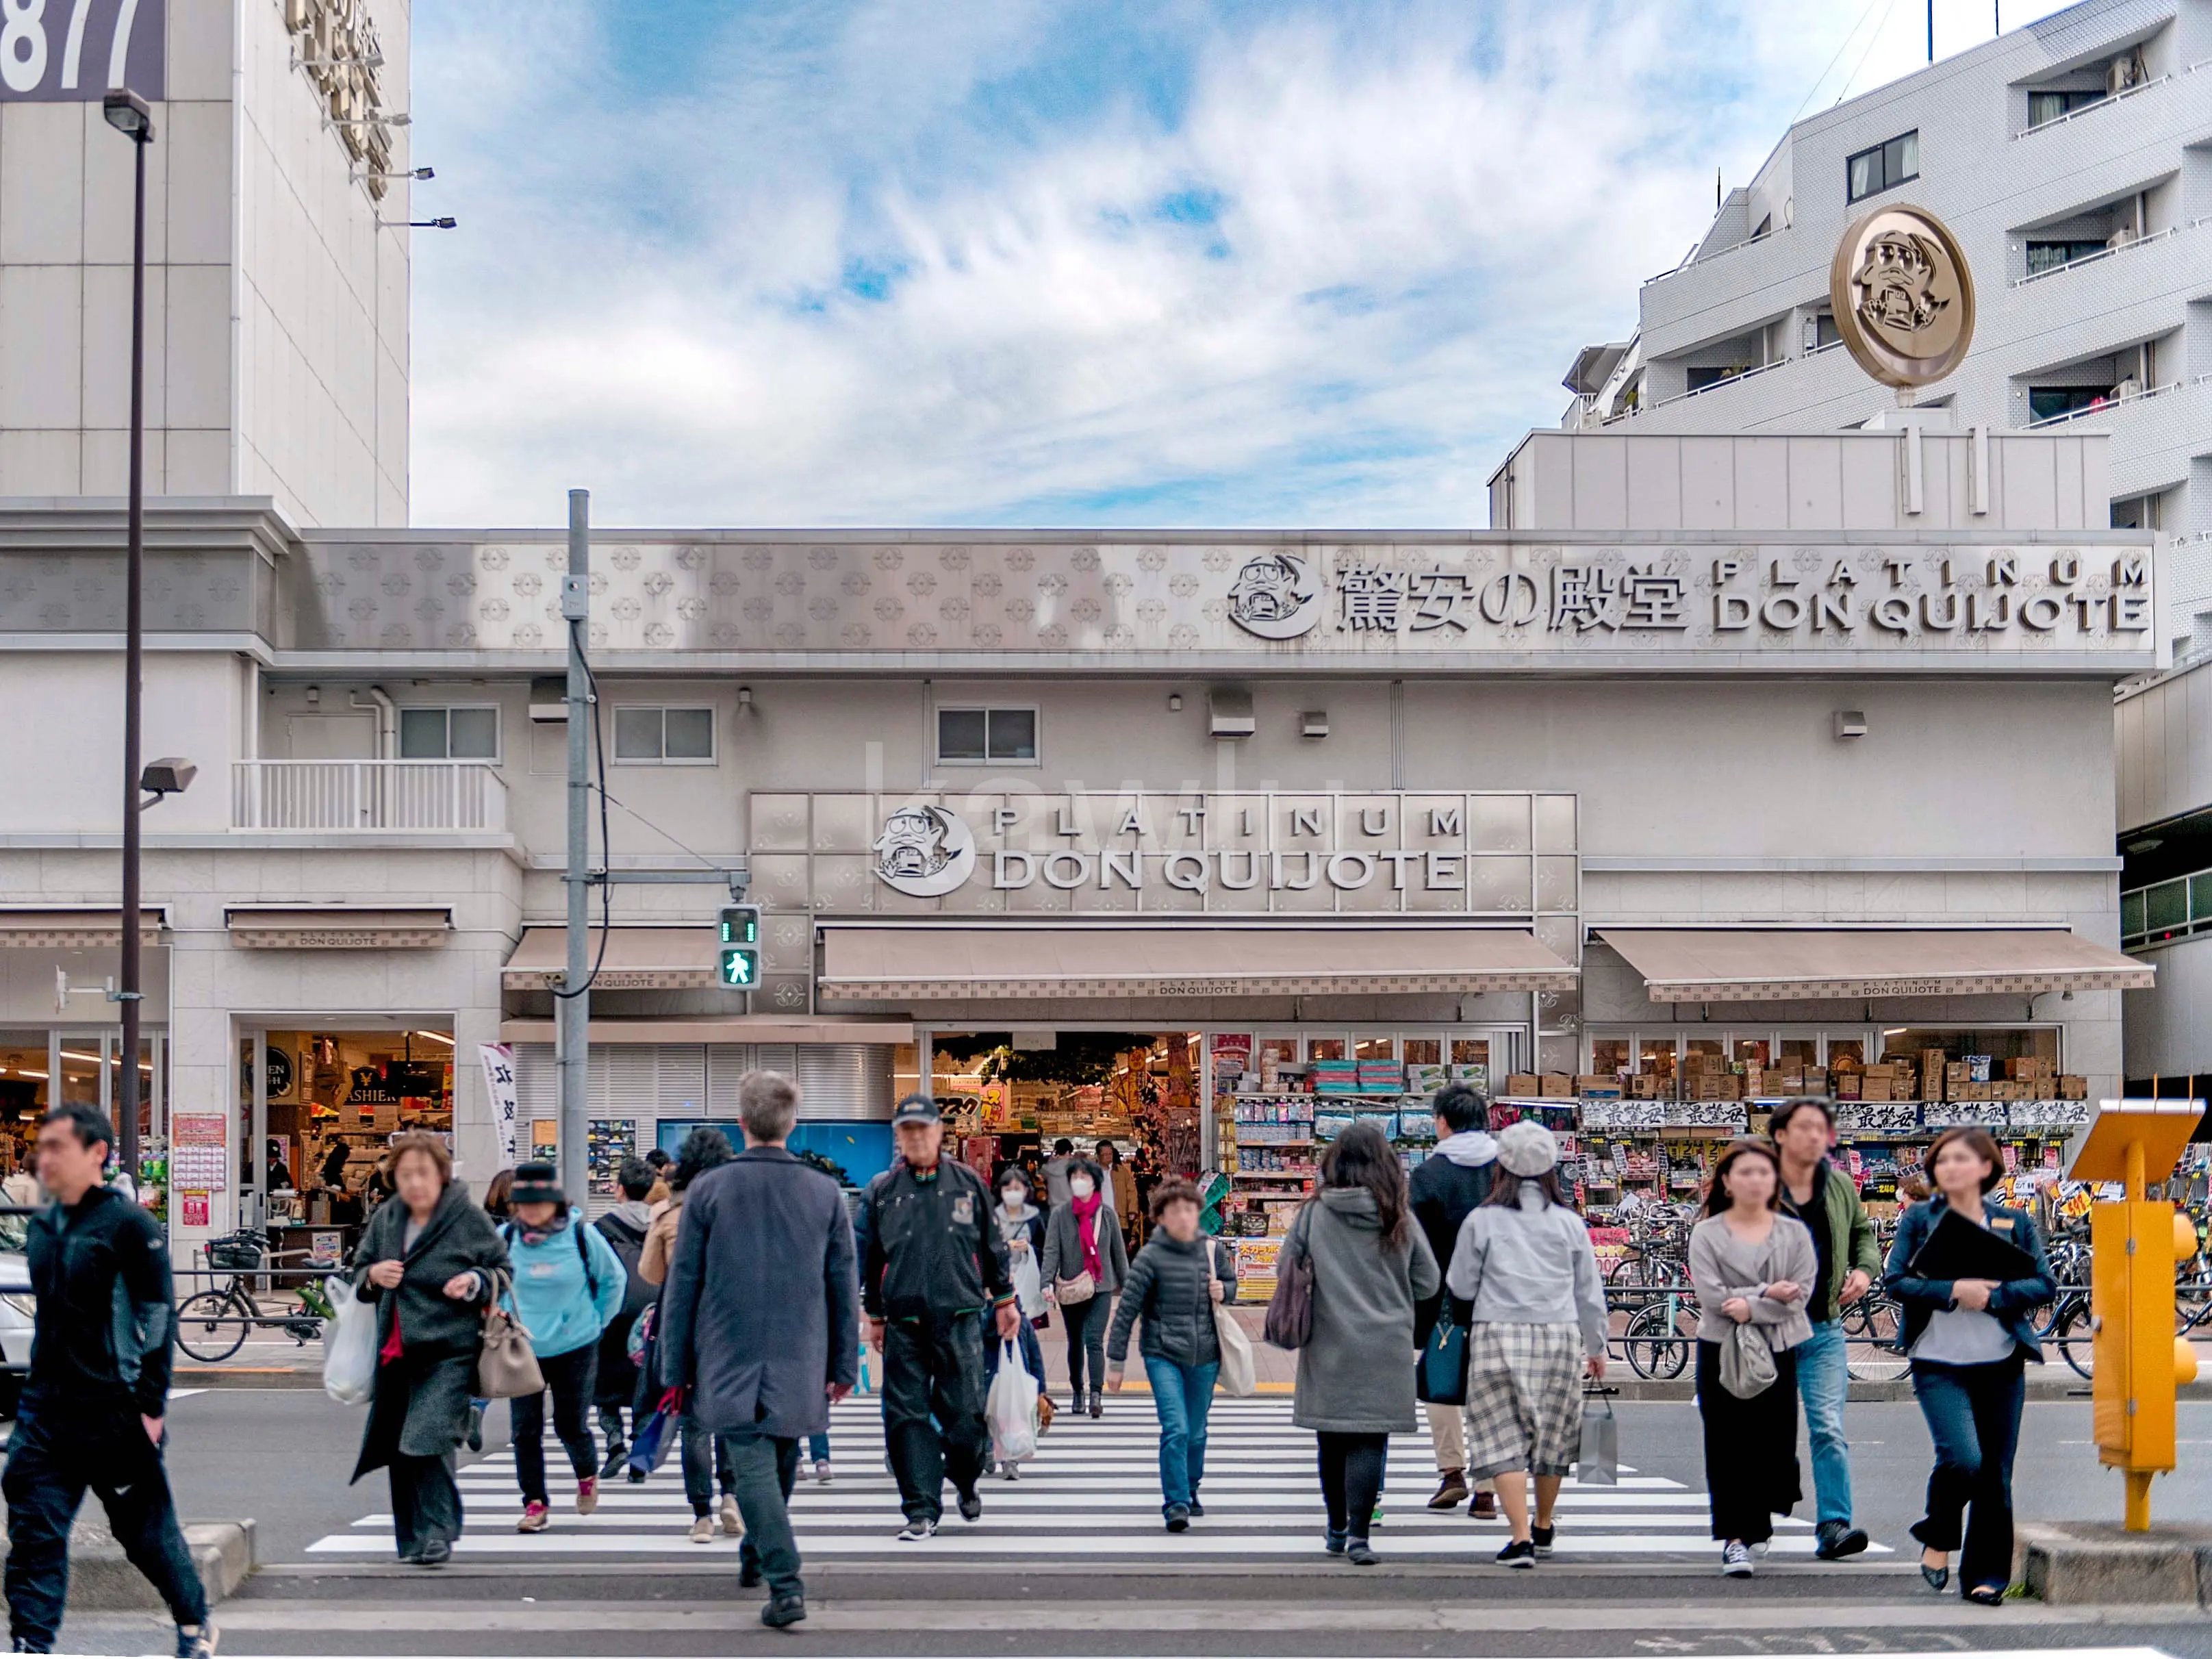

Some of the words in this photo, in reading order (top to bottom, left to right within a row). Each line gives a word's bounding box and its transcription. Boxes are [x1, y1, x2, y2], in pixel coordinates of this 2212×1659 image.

[1714, 559, 2146, 590] PLATINUM
[1337, 563, 1688, 631] 驚安の殿堂
[1716, 593, 1853, 631] DON
[1870, 593, 2148, 635] QUIJOTE
[994, 807, 1464, 836] PLATINUM
[994, 850, 1143, 890] DON
[1164, 850, 1465, 896] QUIJOTE
[300, 937, 325, 946] DON
[327, 937, 377, 946] QUIJOTE
[604, 979, 654, 987] QUIJOTE
[1160, 987, 1186, 995] DON
[1187, 986, 1238, 995] QUIJOTE
[1863, 979, 1941, 987] PLATINUM
[1864, 987, 1889, 996] DON
[1892, 986, 1942, 995] QUIJOTE
[1606, 1102, 1665, 1125] 最驚安
[1688, 1102, 1747, 1125] 最驚安
[1857, 1105, 1917, 1129] 最驚安
[2033, 1100, 2089, 1125] 最驚安
[1878, 1185, 1896, 1193] 248
